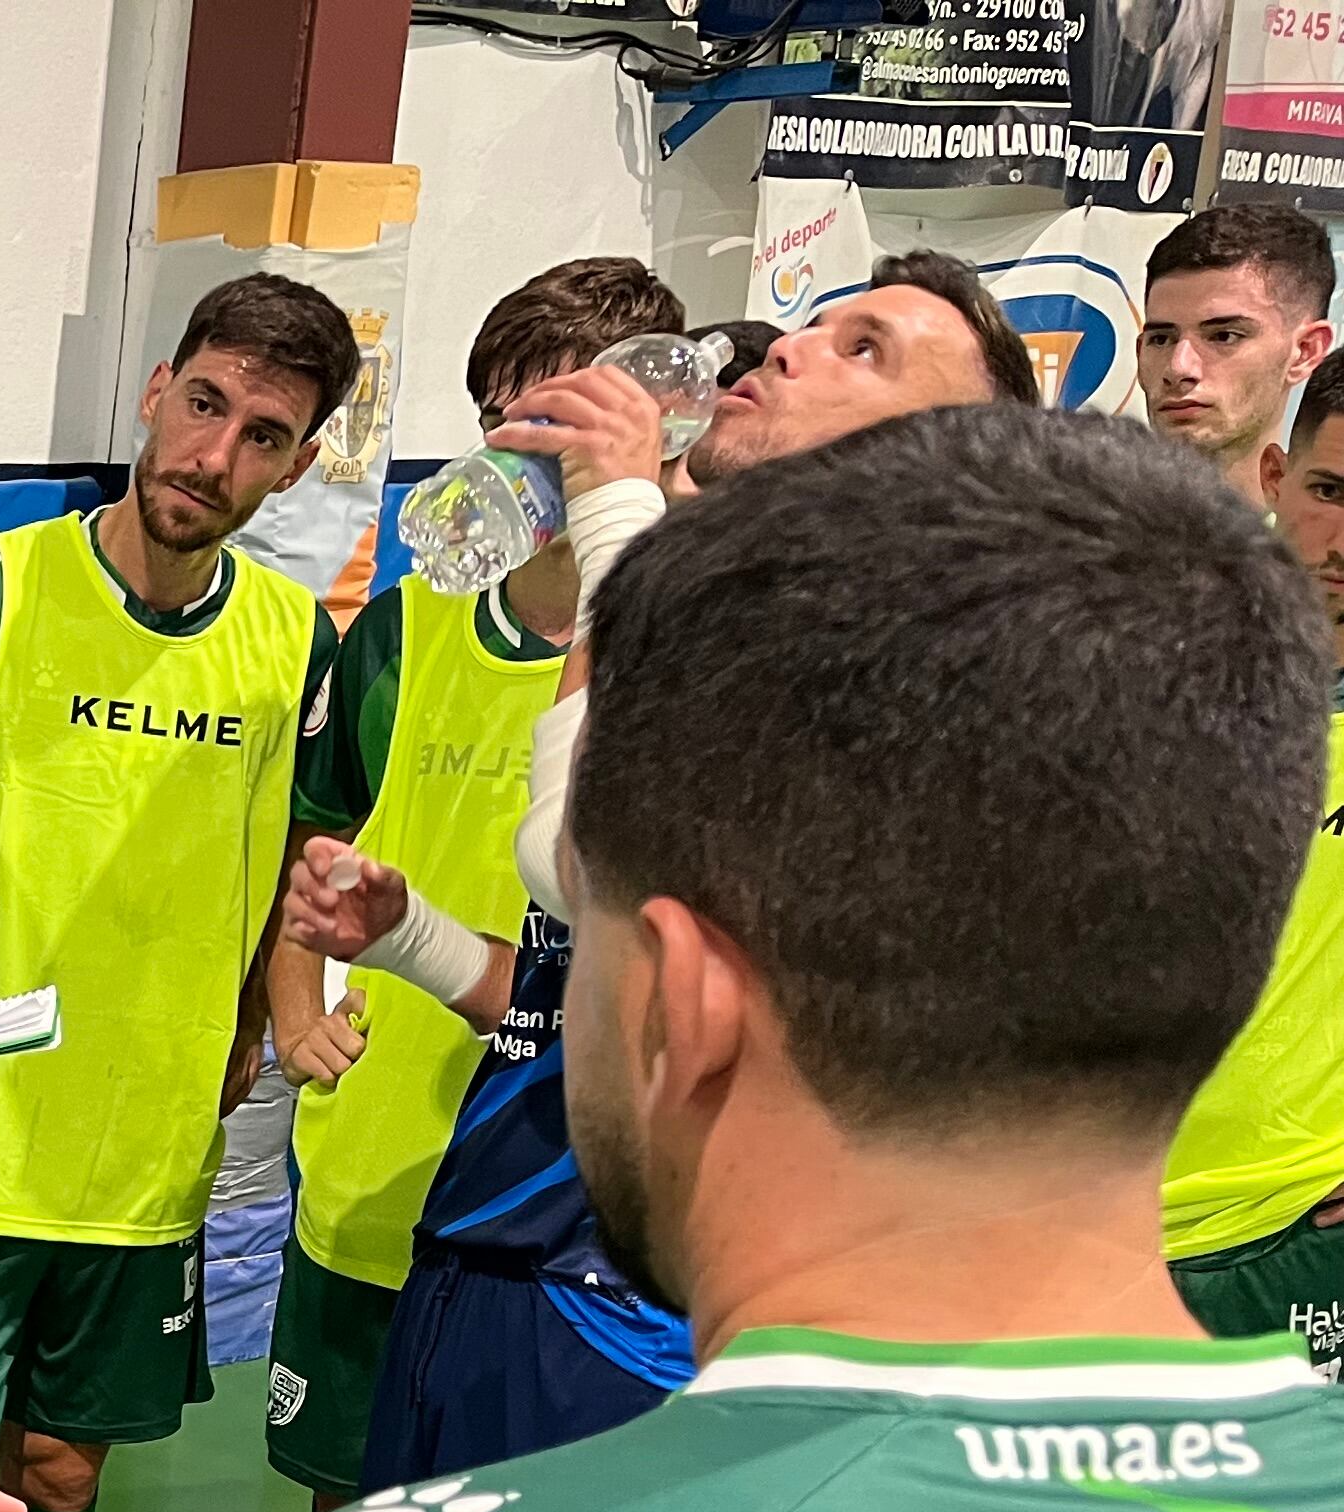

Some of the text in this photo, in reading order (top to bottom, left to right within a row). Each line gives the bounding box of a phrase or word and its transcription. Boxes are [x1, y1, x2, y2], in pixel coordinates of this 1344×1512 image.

[925, 28, 945, 49] 66
[963, 29, 1001, 51] Fax:
[1005, 29, 1040, 52] 952
[1043, 31, 1062, 53] 45
[1302, 11, 1332, 41] 45
[945, 124, 994, 159] CON
[998, 123, 1029, 156] LA
[1030, 123, 1064, 159] U.D.
[70, 694, 243, 747] KELME
[494, 1033, 537, 1060] Mga
[955, 1419, 1263, 1484] uma.es
